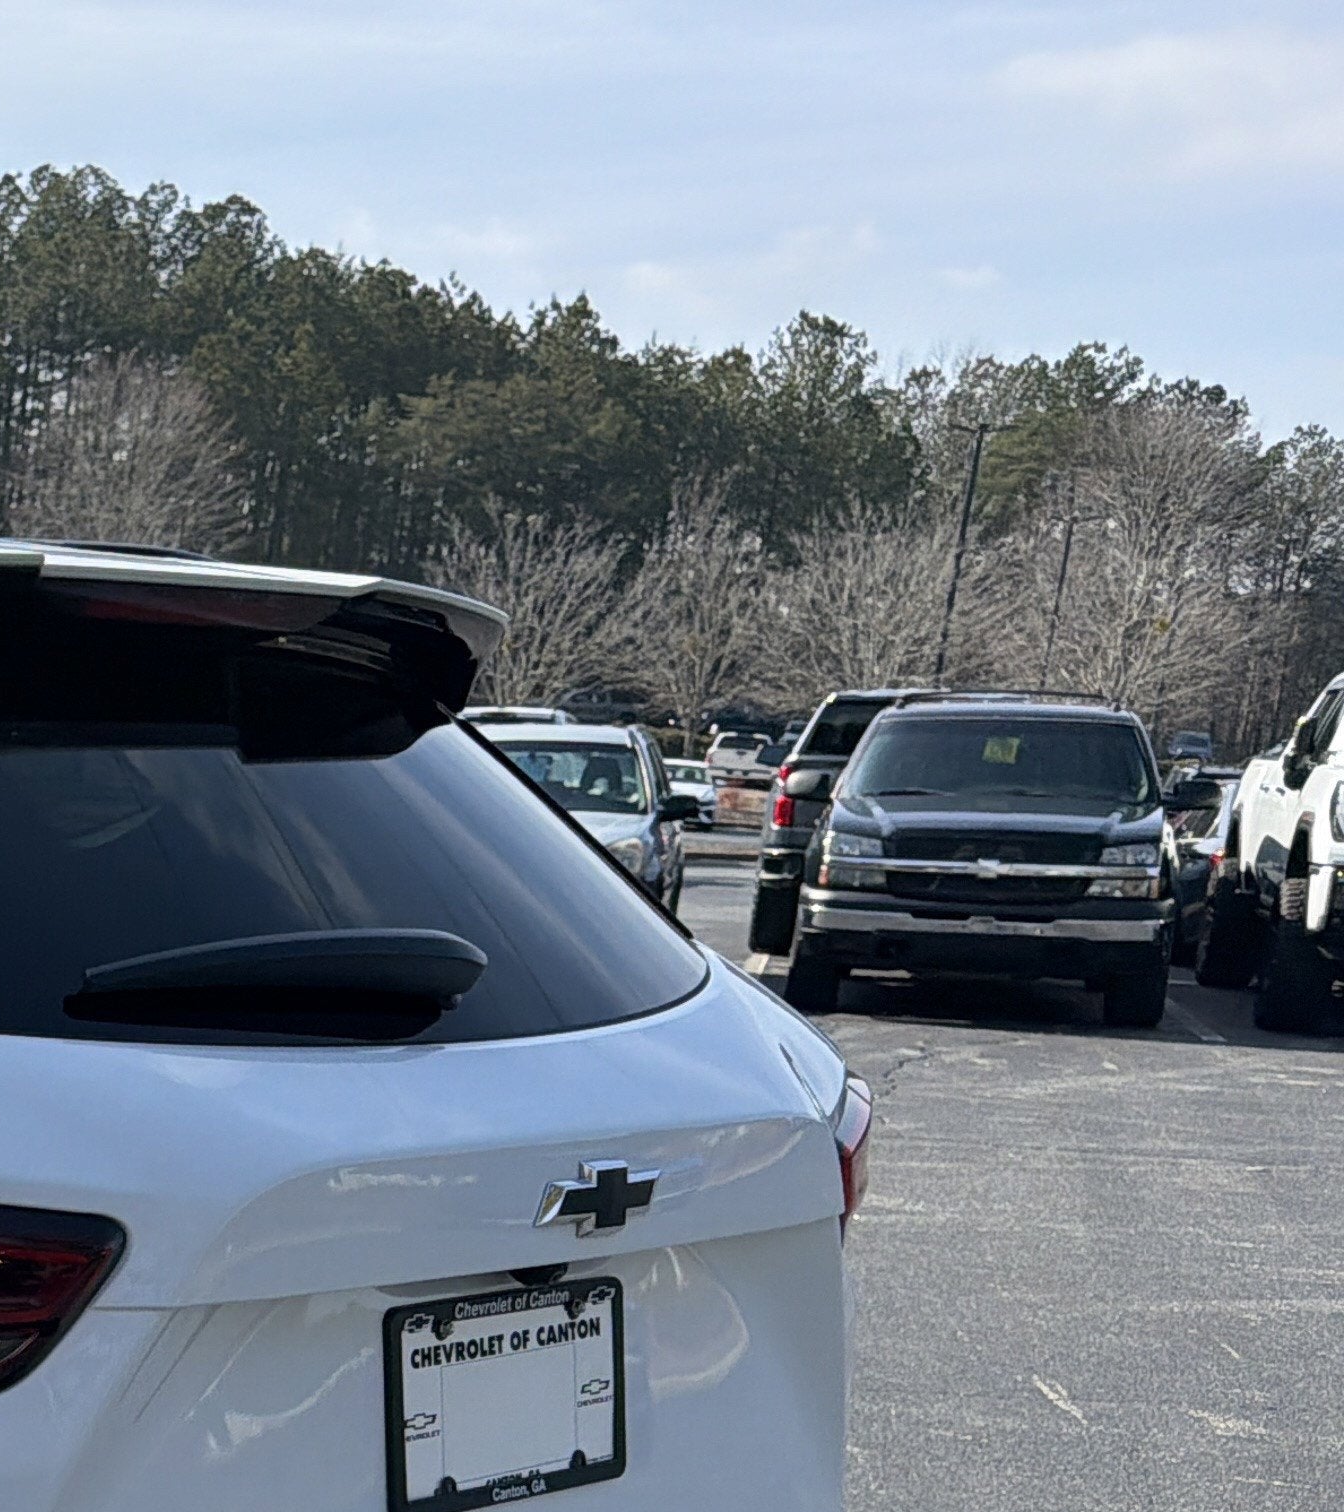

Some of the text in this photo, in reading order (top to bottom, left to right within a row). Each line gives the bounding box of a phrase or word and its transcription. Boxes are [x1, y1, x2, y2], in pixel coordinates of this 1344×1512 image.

[454, 1289, 571, 1319] Chevrolet of Canton
[410, 1317, 601, 1369] CHEVROLET OF CANTON
[531, 1477, 548, 1493] GA
